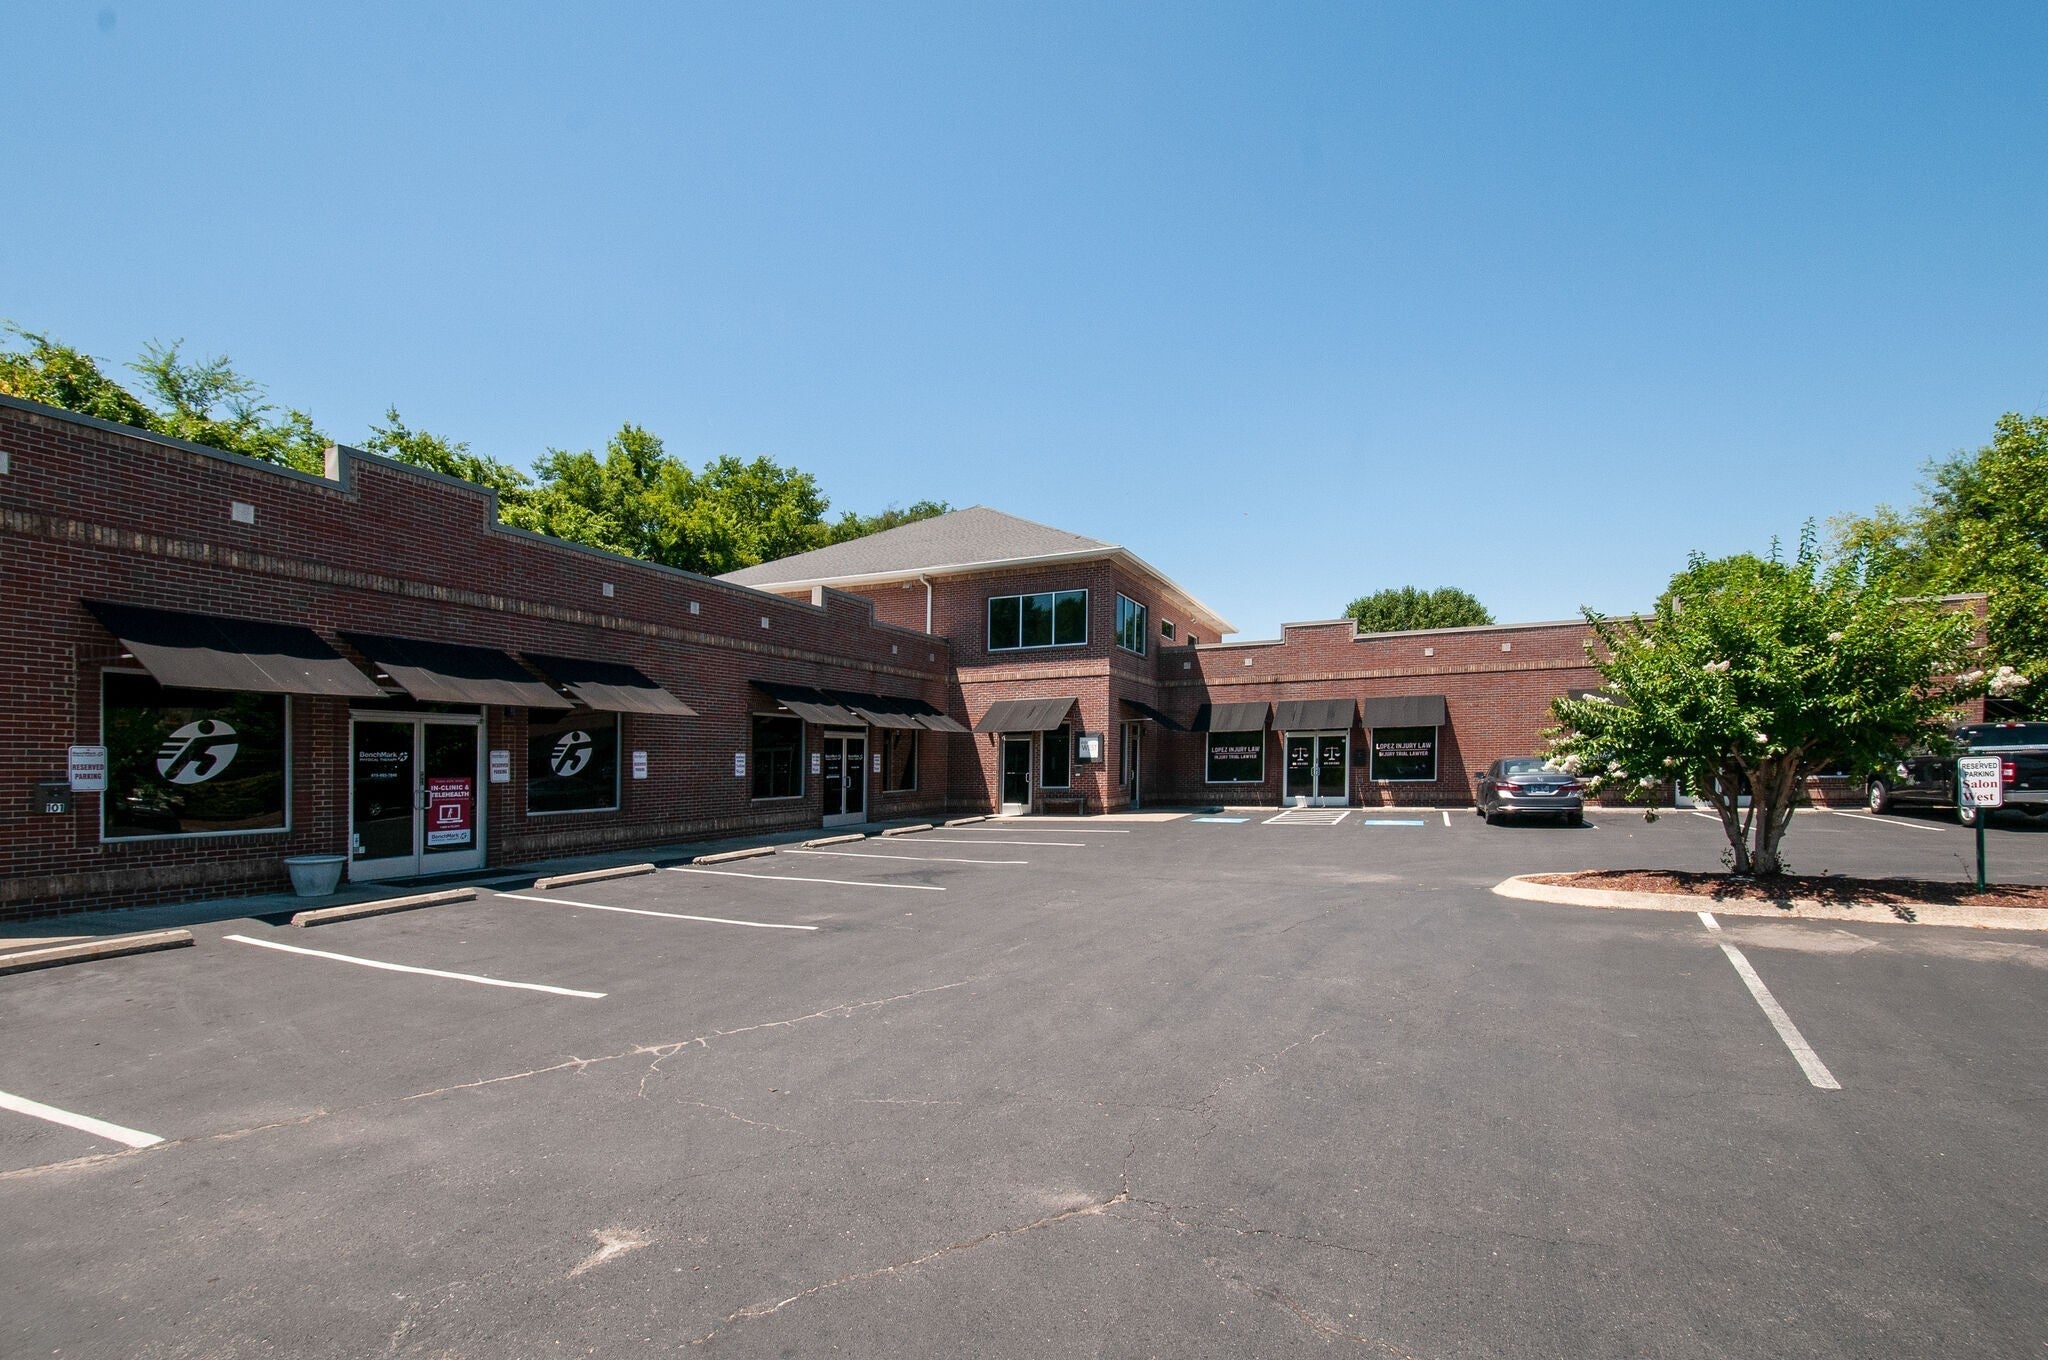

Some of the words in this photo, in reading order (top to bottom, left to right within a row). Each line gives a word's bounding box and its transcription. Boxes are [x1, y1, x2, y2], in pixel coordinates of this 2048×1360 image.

[1962, 780, 1998, 789] Salon
[1963, 792, 1994, 801] West
[46, 803, 65, 813] 101
